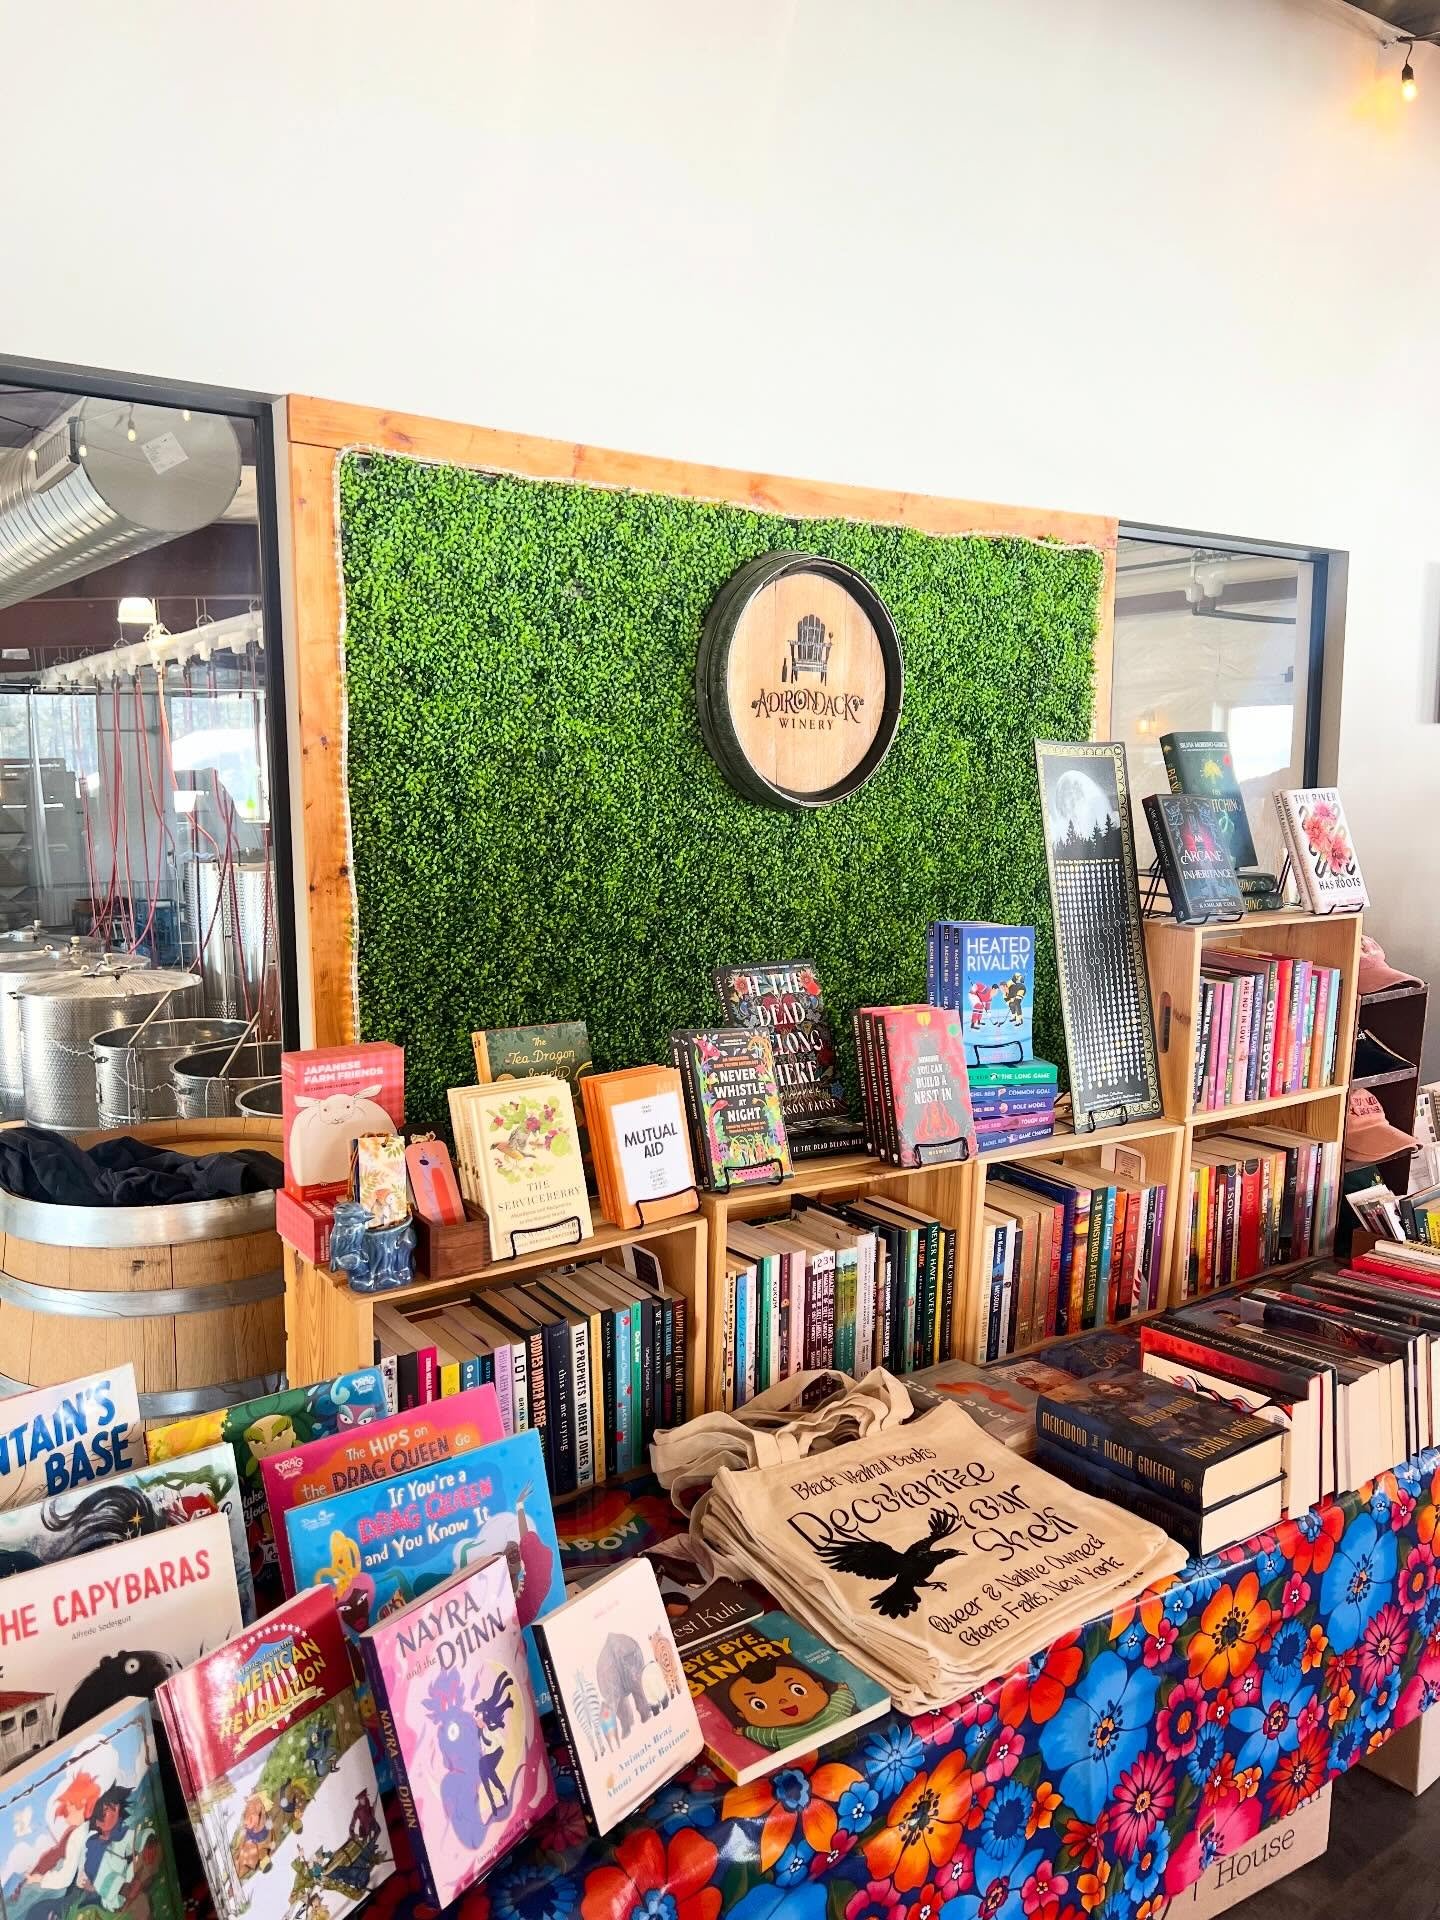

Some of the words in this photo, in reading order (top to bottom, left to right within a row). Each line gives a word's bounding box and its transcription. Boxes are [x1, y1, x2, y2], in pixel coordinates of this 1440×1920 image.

[754, 688, 861, 723] ADIRONDACK
[779, 717, 834, 731] WINERY
[1294, 793, 1310, 804] THE
[1312, 792, 1336, 802] RIVER
[1194, 834, 1203, 842] AN
[1181, 850, 1224, 865] ARCANE
[1183, 869, 1233, 880] INHERITANCE
[1319, 880, 1334, 890] HAS
[1336, 877, 1361, 888] ROOTS
[967, 936, 1031, 954] HEATED
[967, 953, 1030, 972] RIVALRY
[746, 976, 763, 996] IF
[757, 1002, 806, 1027] DEAD
[1241, 1015, 1247, 1024] IN
[1265, 1000, 1275, 1030] ONE
[532, 1037, 546, 1047] The
[770, 1030, 824, 1056] LONG
[304, 1061, 361, 1075] JAPANESE
[509, 1052, 529, 1065] Tea
[533, 1049, 575, 1064] Dragon
[917, 1066, 929, 1076] YOU
[929, 1065, 943, 1075] CAN
[1261, 1042, 1271, 1080] BOYS
[304, 1073, 336, 1085] FARM
[338, 1067, 384, 1081] FRIENDS
[720, 1068, 757, 1083] NEVER
[916, 1077, 939, 1088] BUILD
[941, 1076, 947, 1085] A
[714, 1082, 765, 1098] WHISTLE
[914, 1089, 941, 1104] NEST
[942, 1087, 953, 1101] IN
[727, 1107, 760, 1122] NIGHT
[624, 1122, 678, 1148] MUTUAL
[1032, 1128, 1051, 1136] CHANGER
[644, 1142, 664, 1159] AID
[497, 1186, 581, 1212] SERVICEBERRY
[527, 1180, 551, 1192] THE
[1226, 1192, 1234, 1225] SONG
[930, 1225, 938, 1257] NEVER
[1091, 1213, 1102, 1262] MONSTROUS
[945, 1281, 953, 1309] SILVER
[1087, 1263, 1098, 1312] AFFECTIONS
[655, 1310, 662, 1325] WE
[674, 1304, 684, 1345] VAMPIRES
[530, 1333, 544, 1369] BODIES
[575, 1330, 585, 1348] THE
[514, 1354, 526, 1383] LOT
[558, 1369, 567, 1388] this
[576, 1350, 587, 1396] PROPHETS
[675, 1368, 685, 1393] NORTE
[530, 1369, 545, 1400] UNDER
[560, 1391, 566, 1401] is
[533, 1400, 546, 1427] SIEGE
[560, 1404, 568, 1418] me
[577, 1403, 588, 1436] ROBERT
[346, 1446, 366, 1462] The
[368, 1427, 410, 1457] HIPS
[413, 1425, 428, 1439] on
[559, 1419, 569, 1451] trying
[44, 1423, 133, 1497] BASE
[578, 1439, 589, 1469] JONES,
[1041, 1411, 1088, 1448] MENEWOOD
[1103, 1439, 1134, 1469] NICOLA
[1138, 1455, 1176, 1489] GRIFFITH
[302, 1483, 326, 1500] the
[331, 1458, 386, 1493] DRAG
[390, 1435, 450, 1472] QUEEN
[454, 1432, 471, 1447] Go
[580, 1470, 590, 1484] JR.
[791, 1475, 840, 1501] Black
[840, 1457, 894, 1489] Walnut
[889, 1446, 937, 1471] Books
[386, 1486, 403, 1509] If
[406, 1475, 455, 1501] You're
[458, 1470, 467, 1483] a
[358, 1502, 421, 1545] DRAG
[427, 1476, 493, 1520] QUEEN
[786, 1460, 996, 1554] Decolonize
[364, 1549, 389, 1567] and
[392, 1529, 423, 1559] You
[427, 1518, 469, 1545] Know
[472, 1508, 489, 1527] It
[971, 1505, 1081, 1562] Shelf
[0, 1603, 39, 1645] HE
[53, 1550, 210, 1627] CAPYBARAS
[928, 1597, 981, 1634] Queer
[1000, 1561, 1050, 1595] Native
[1048, 1533, 1105, 1571] Owned
[958, 1610, 1010, 1648] Glens
[1049, 1577, 1084, 1604] New
[1080, 1554, 1125, 1587] York
[71, 1627, 97, 1641] Alfredo
[396, 1591, 481, 1659] NAYRA
[673, 1618, 700, 1639] est
[695, 1601, 747, 1629] Kulu
[436, 1608, 506, 1671] DJINN
[683, 1650, 719, 1674] BYE
[718, 1633, 766, 1655] BYE,
[229, 1639, 321, 1706] AMERICAN
[688, 1637, 793, 1698] BINARY
[226, 1655, 326, 1736] REVOLUTION
[618, 1740, 652, 1772] Animals
[653, 1726, 673, 1749] Brag
[378, 1710, 399, 1759] NAYRA
[398, 1785, 417, 1830] DJINN
[634, 1753, 657, 1777] Their
[1213, 1827, 1295, 1890] House
